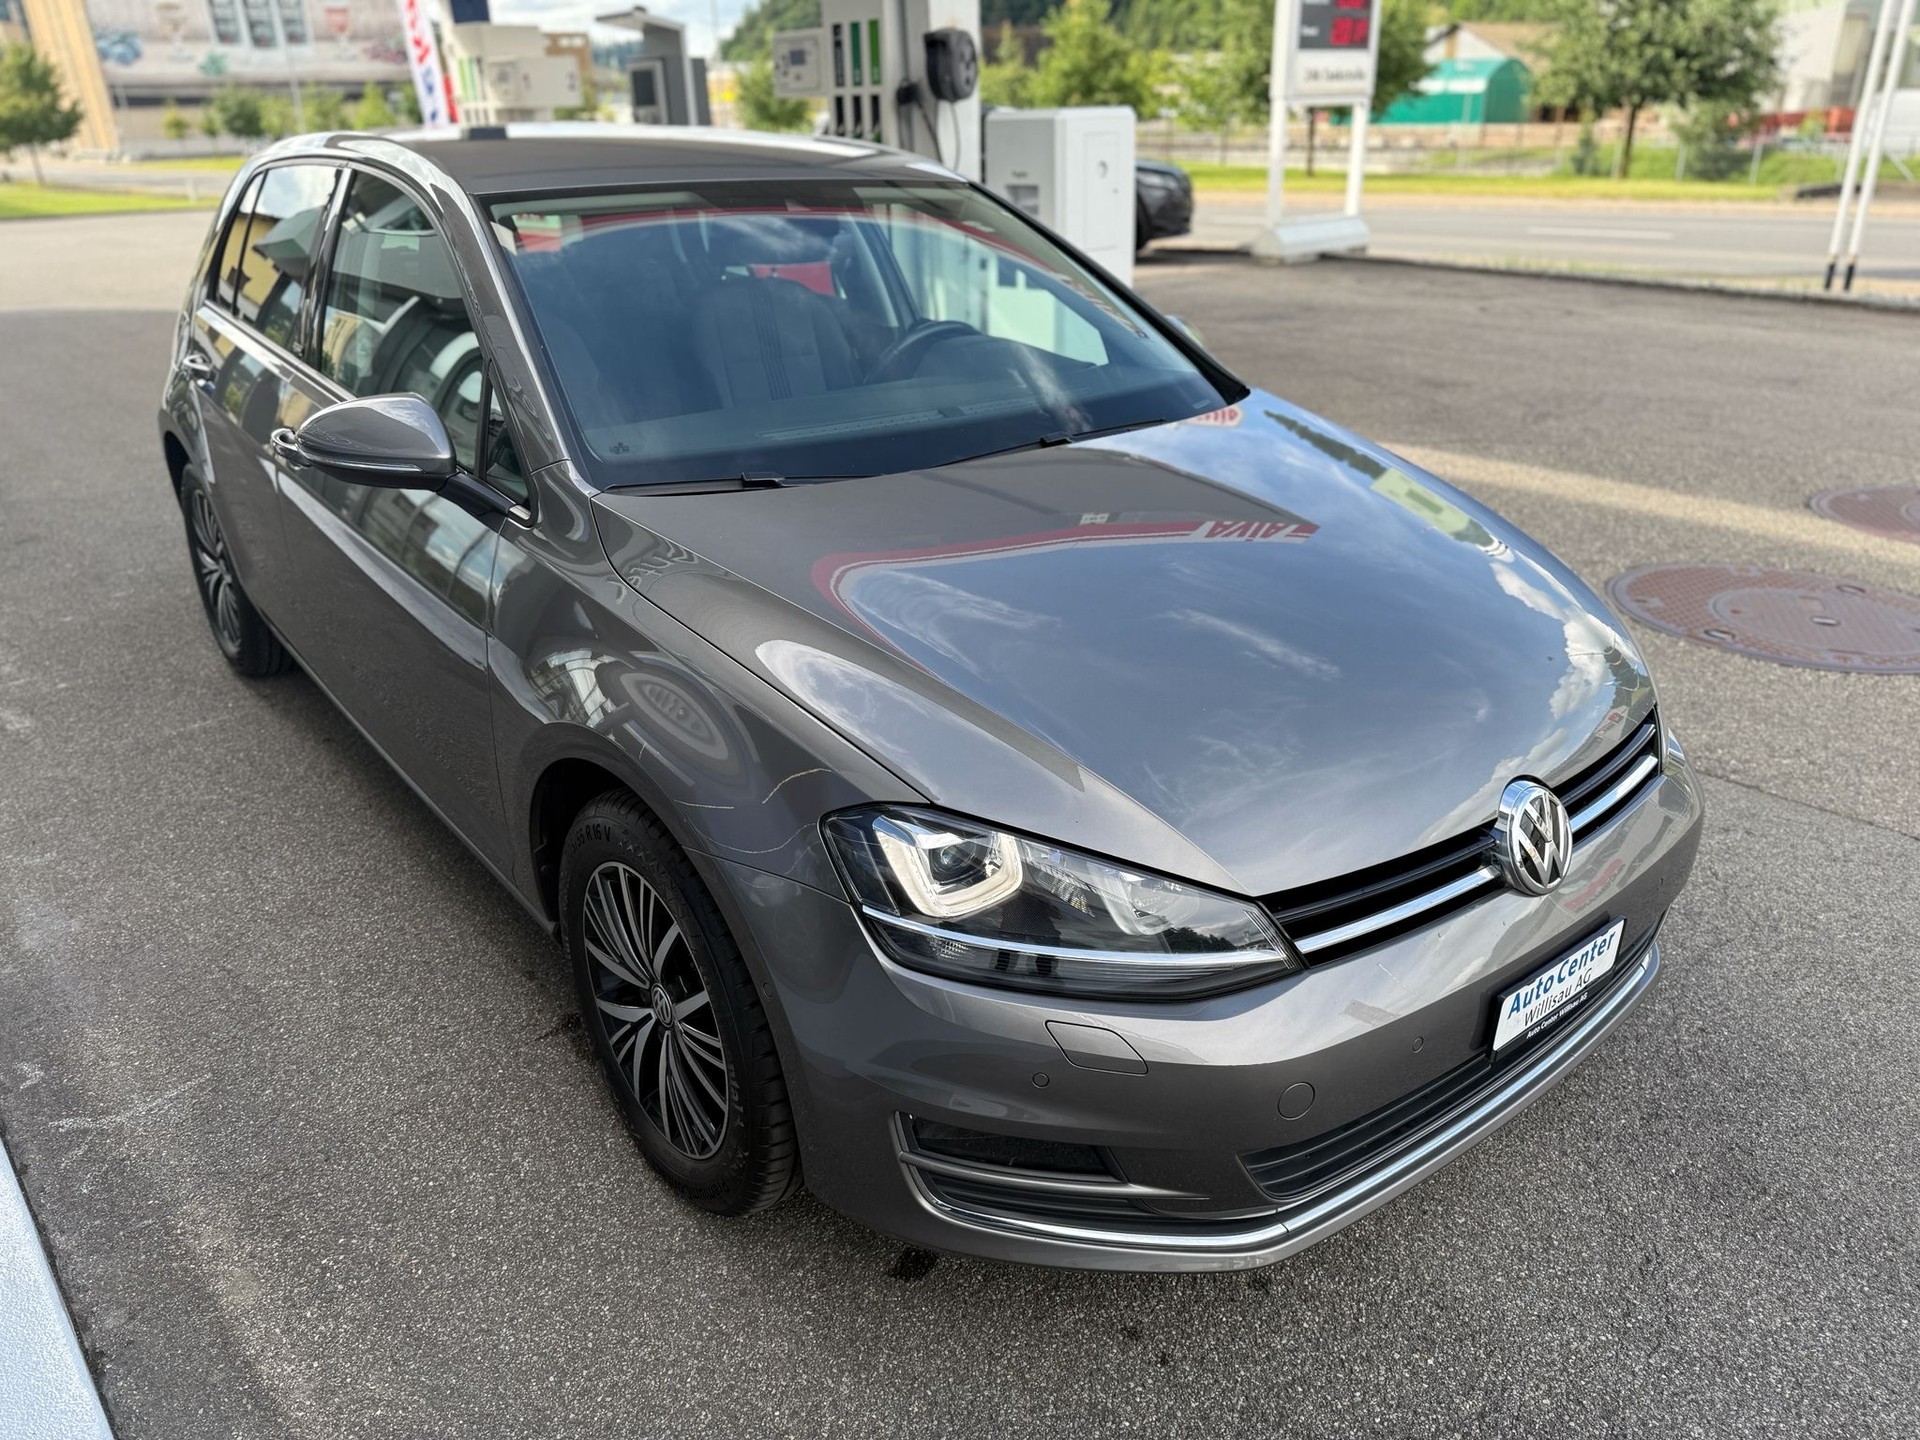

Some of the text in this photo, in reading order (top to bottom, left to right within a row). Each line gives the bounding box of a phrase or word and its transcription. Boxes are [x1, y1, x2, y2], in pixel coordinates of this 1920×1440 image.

[1524, 967, 1593, 1027] Willisau AG
[1526, 992, 1588, 1039] Auto Center Willisau AG
